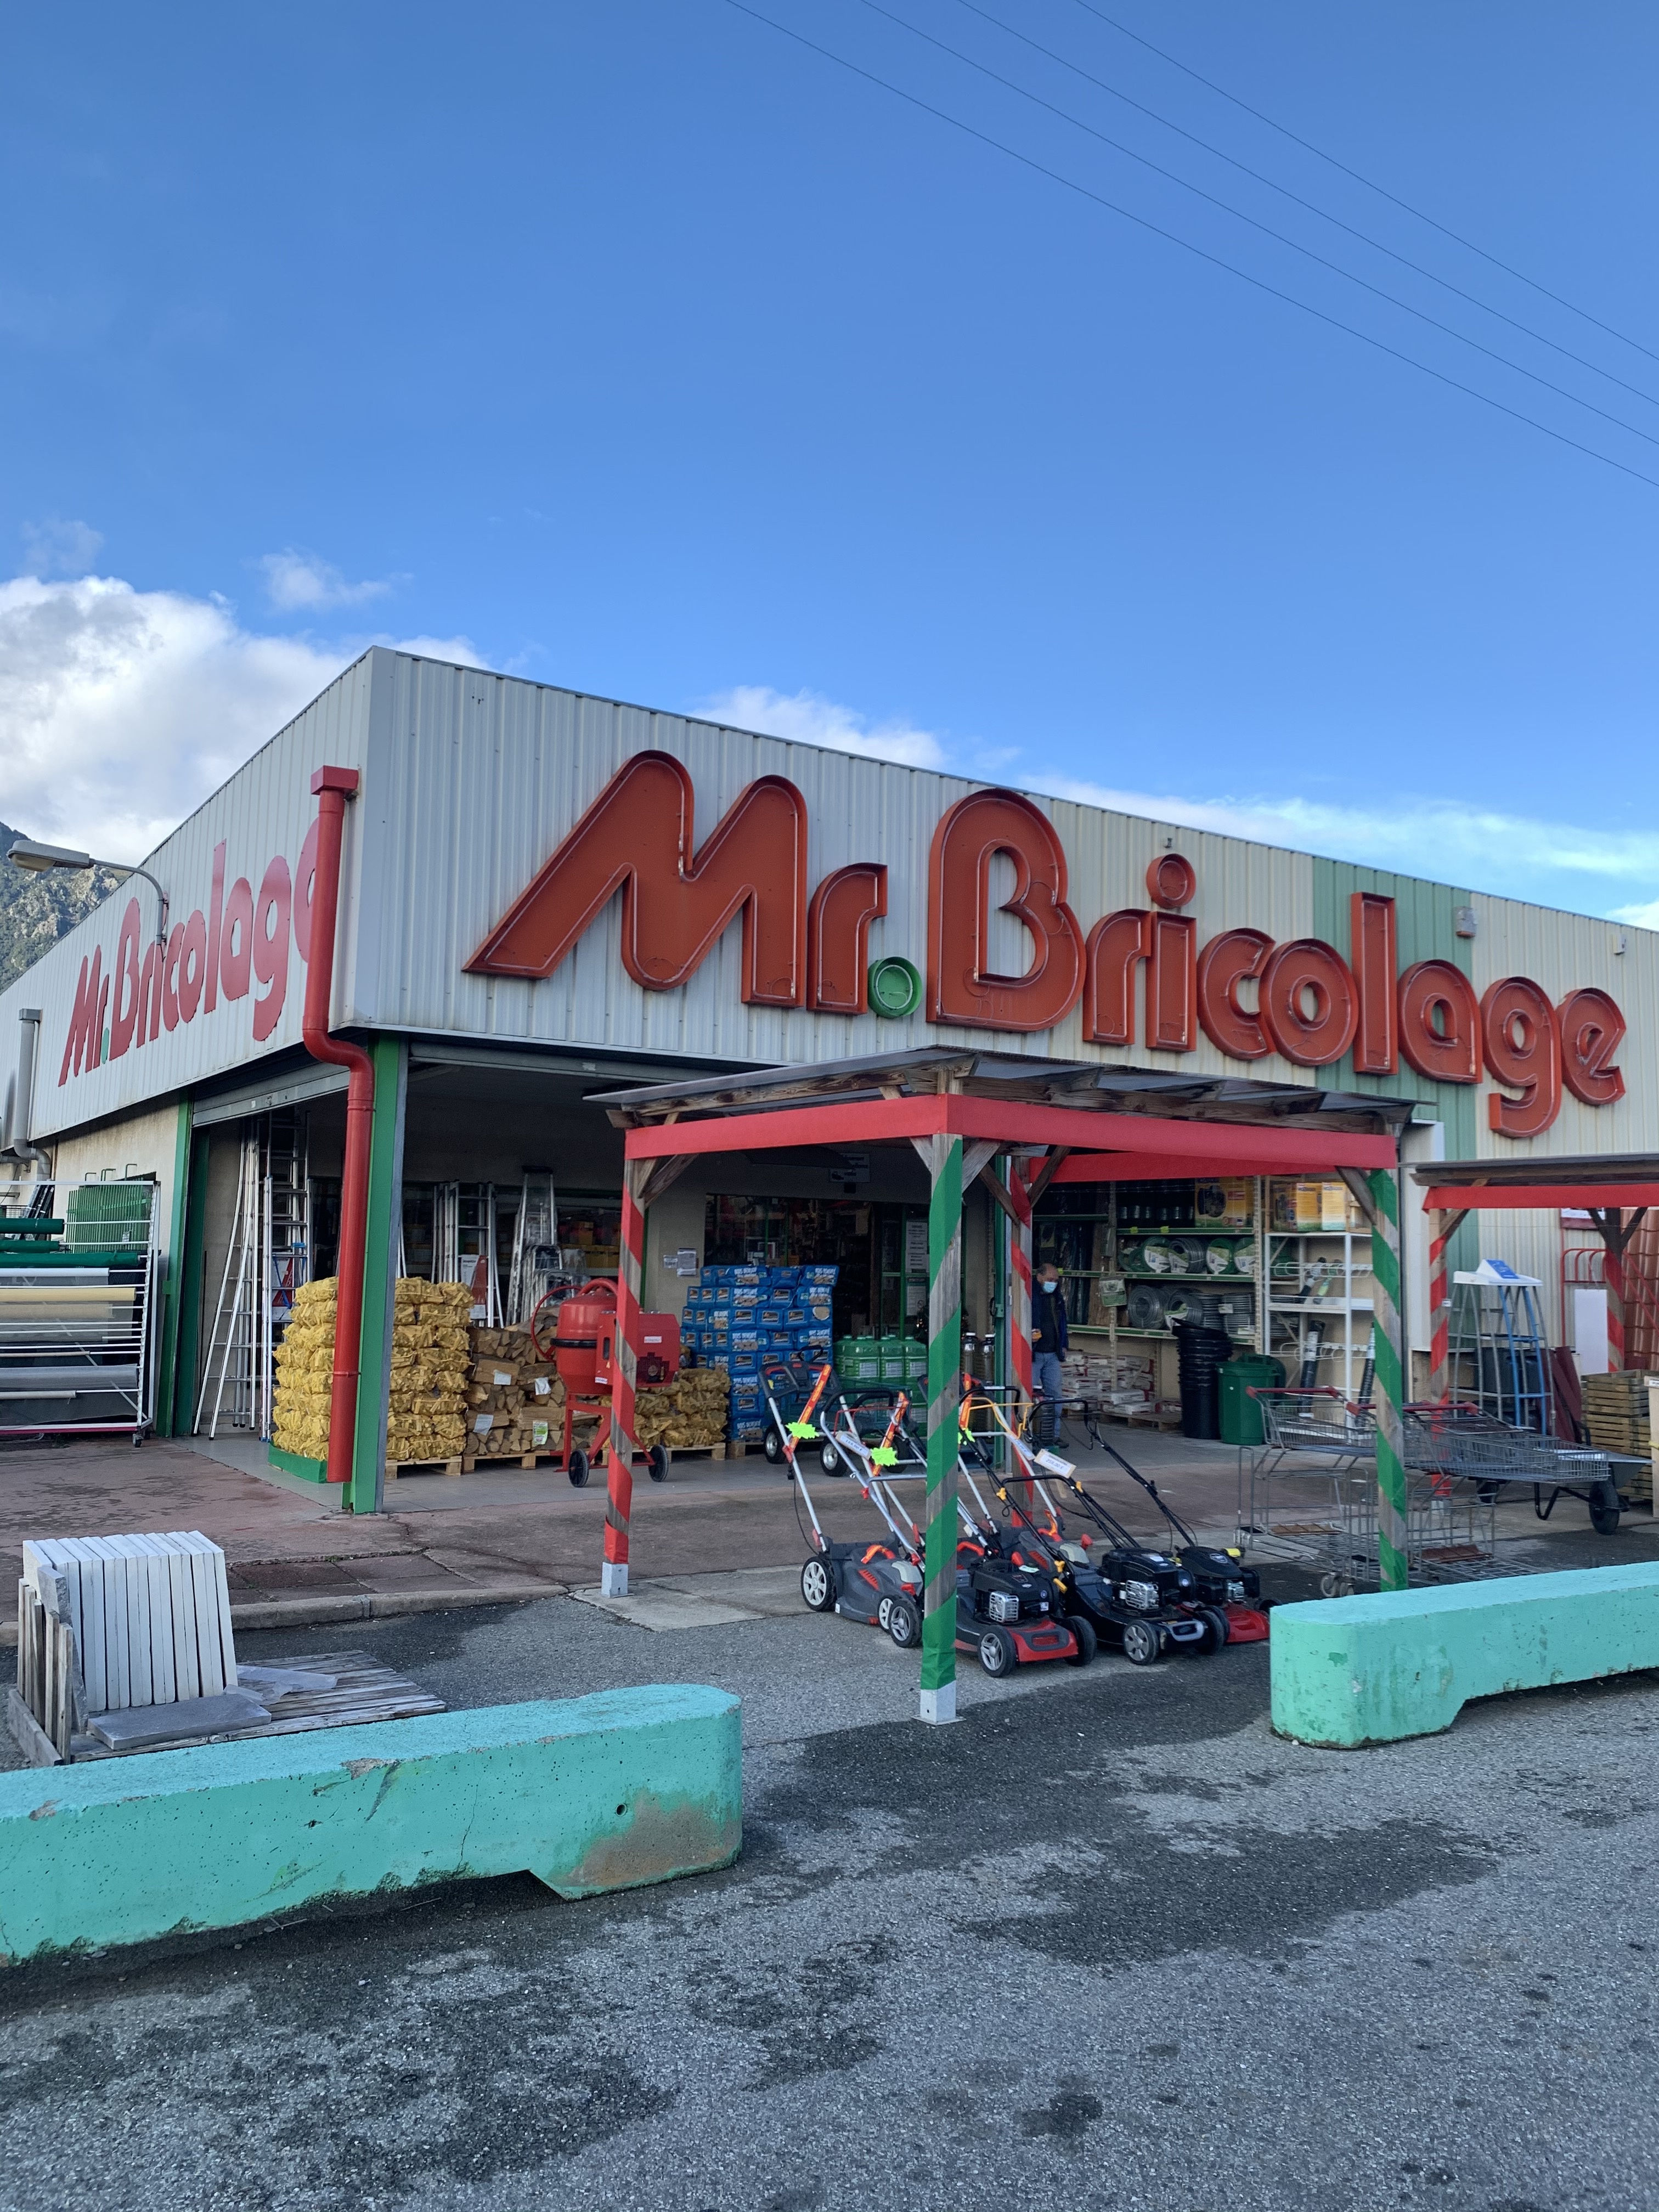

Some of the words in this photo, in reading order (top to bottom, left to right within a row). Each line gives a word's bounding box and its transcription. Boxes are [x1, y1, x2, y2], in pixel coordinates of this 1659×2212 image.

[58, 943, 110, 1087] Mr.
[461, 749, 923, 1019] Mr.
[927, 788, 1627, 1138] Bricolage
